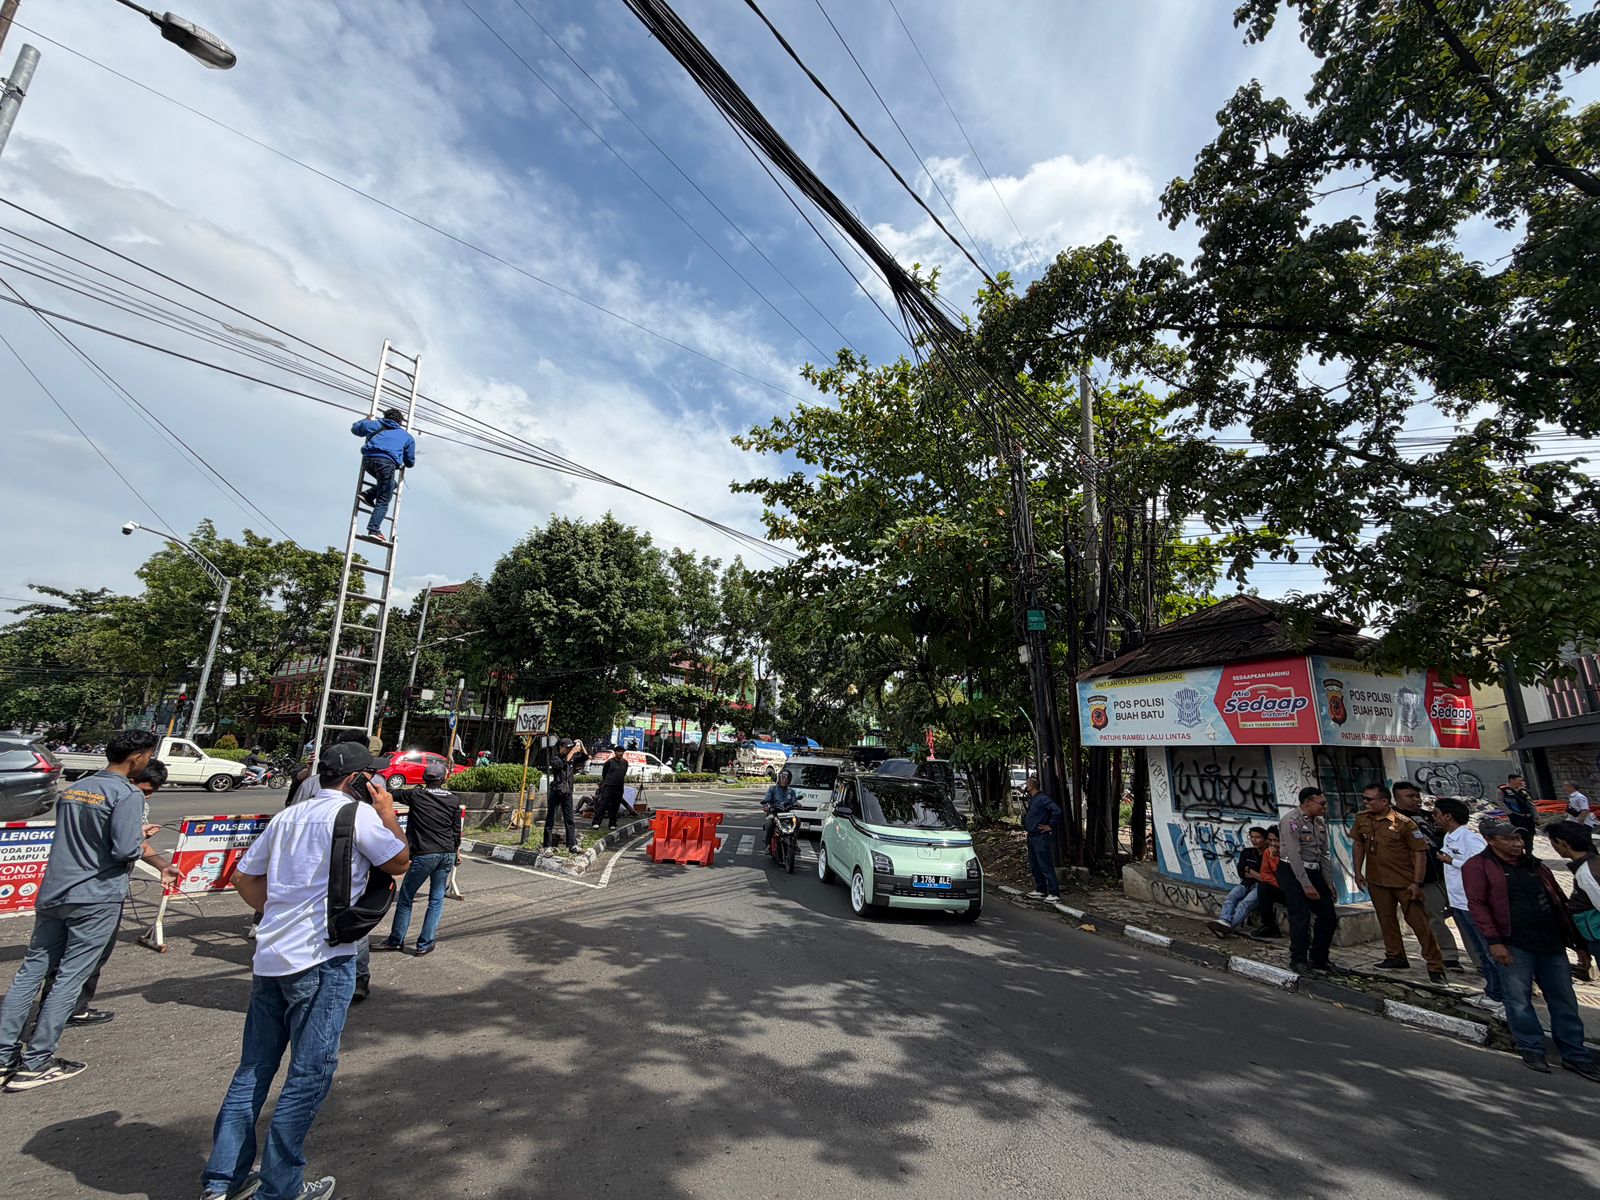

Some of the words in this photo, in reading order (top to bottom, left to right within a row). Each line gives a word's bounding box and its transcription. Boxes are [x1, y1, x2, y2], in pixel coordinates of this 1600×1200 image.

[1150, 674, 1183, 682] LENGKONG
[1266, 670, 1290, 678] HARIMU
[1232, 690, 1250, 698] Mie
[1349, 690, 1366, 701] POS
[1367, 692, 1392, 703] POLISI
[1113, 699, 1132, 710] POS
[1133, 697, 1165, 708] POLISI
[1224, 695, 1308, 714] Sedaap
[1115, 711, 1139, 720] BUAH
[1141, 710, 1165, 719] BATU
[1352, 704, 1373, 716] BUAH
[1374, 706, 1393, 717] BATU
[1430, 703, 1472, 721] Sedaap
[1165, 732, 1191, 740] LINTAS
[1341, 732, 1361, 740] PATUHI
[1361, 733, 1381, 742] RAMBU
[1381, 734, 1396, 742] LALU
[1396, 735, 1414, 743] LINTAS
[211, 822, 251, 832] POLSEK
[3, 853, 39, 861] LAMPU
[913, 875, 918, 883] D
[938, 876, 951, 884] ALE
